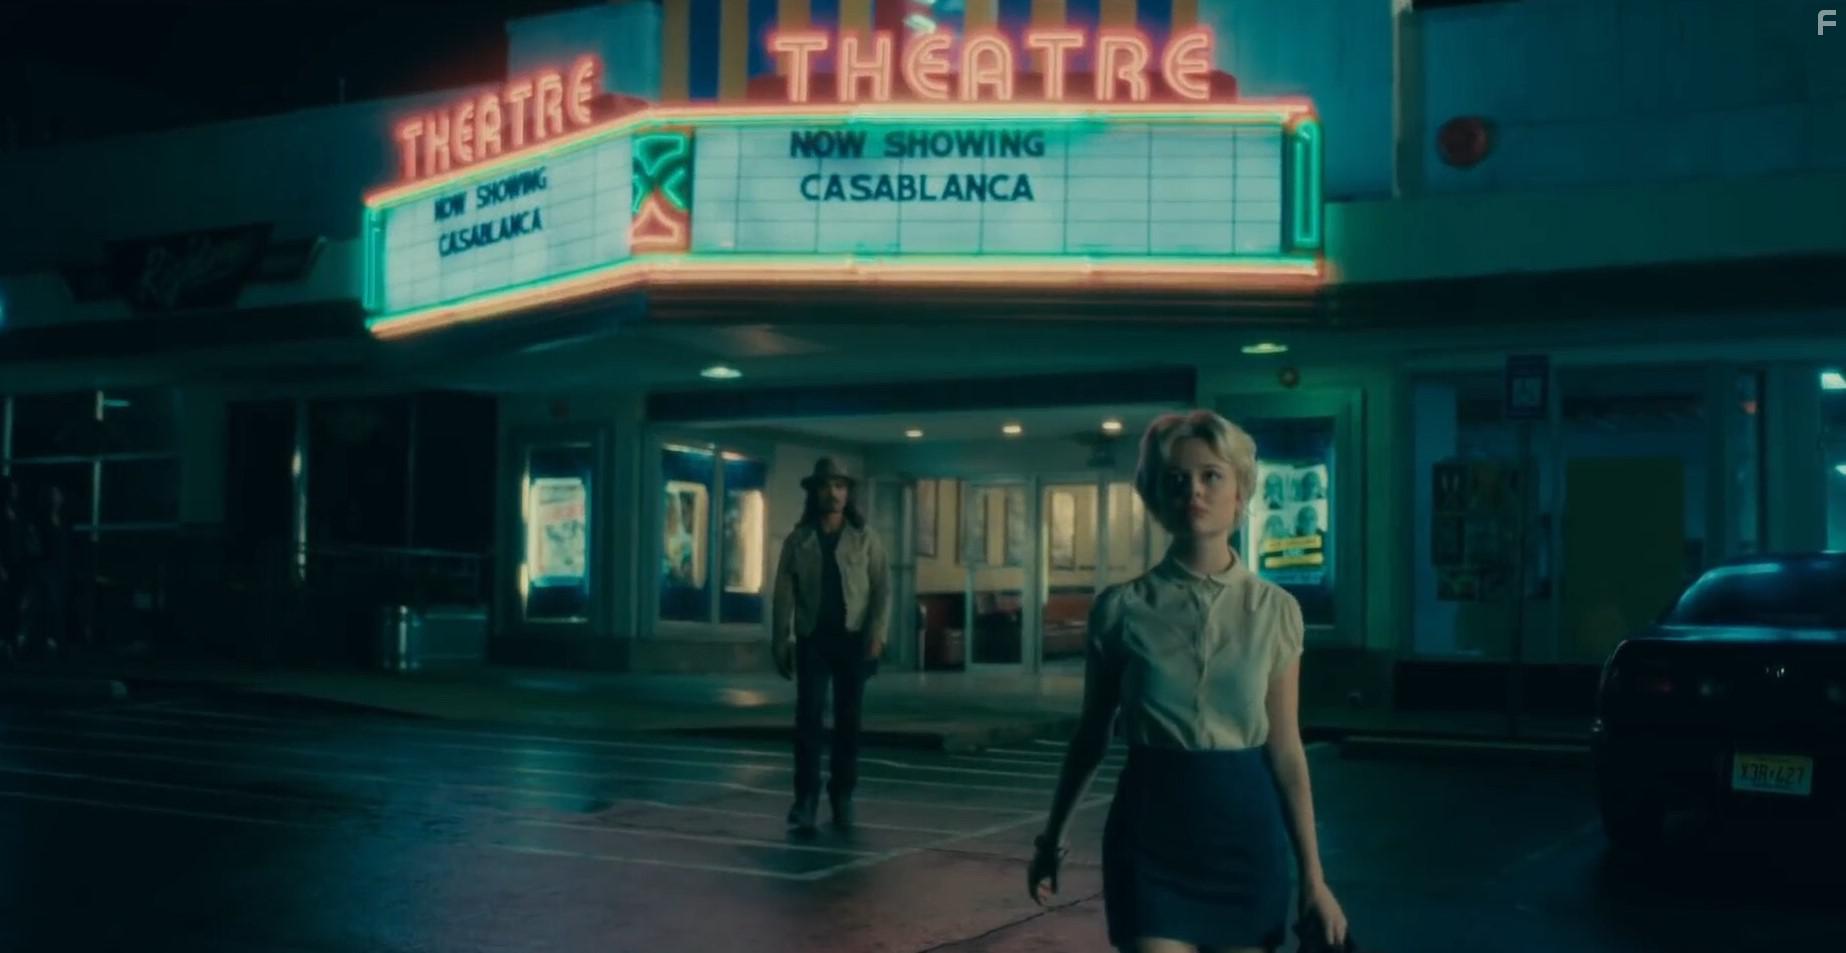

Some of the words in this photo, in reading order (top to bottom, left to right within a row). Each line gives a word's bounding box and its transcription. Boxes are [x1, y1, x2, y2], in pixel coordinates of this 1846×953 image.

[769, 32, 1215, 101] THEATRE
[397, 57, 597, 182] THEATRE
[789, 131, 866, 158] NOW
[884, 130, 1046, 158] SHOWING
[434, 191, 468, 222] NOW
[475, 166, 547, 209] SHOWING
[799, 173, 1035, 201] CASABLANCA
[438, 207, 543, 257] CASABLANCA
